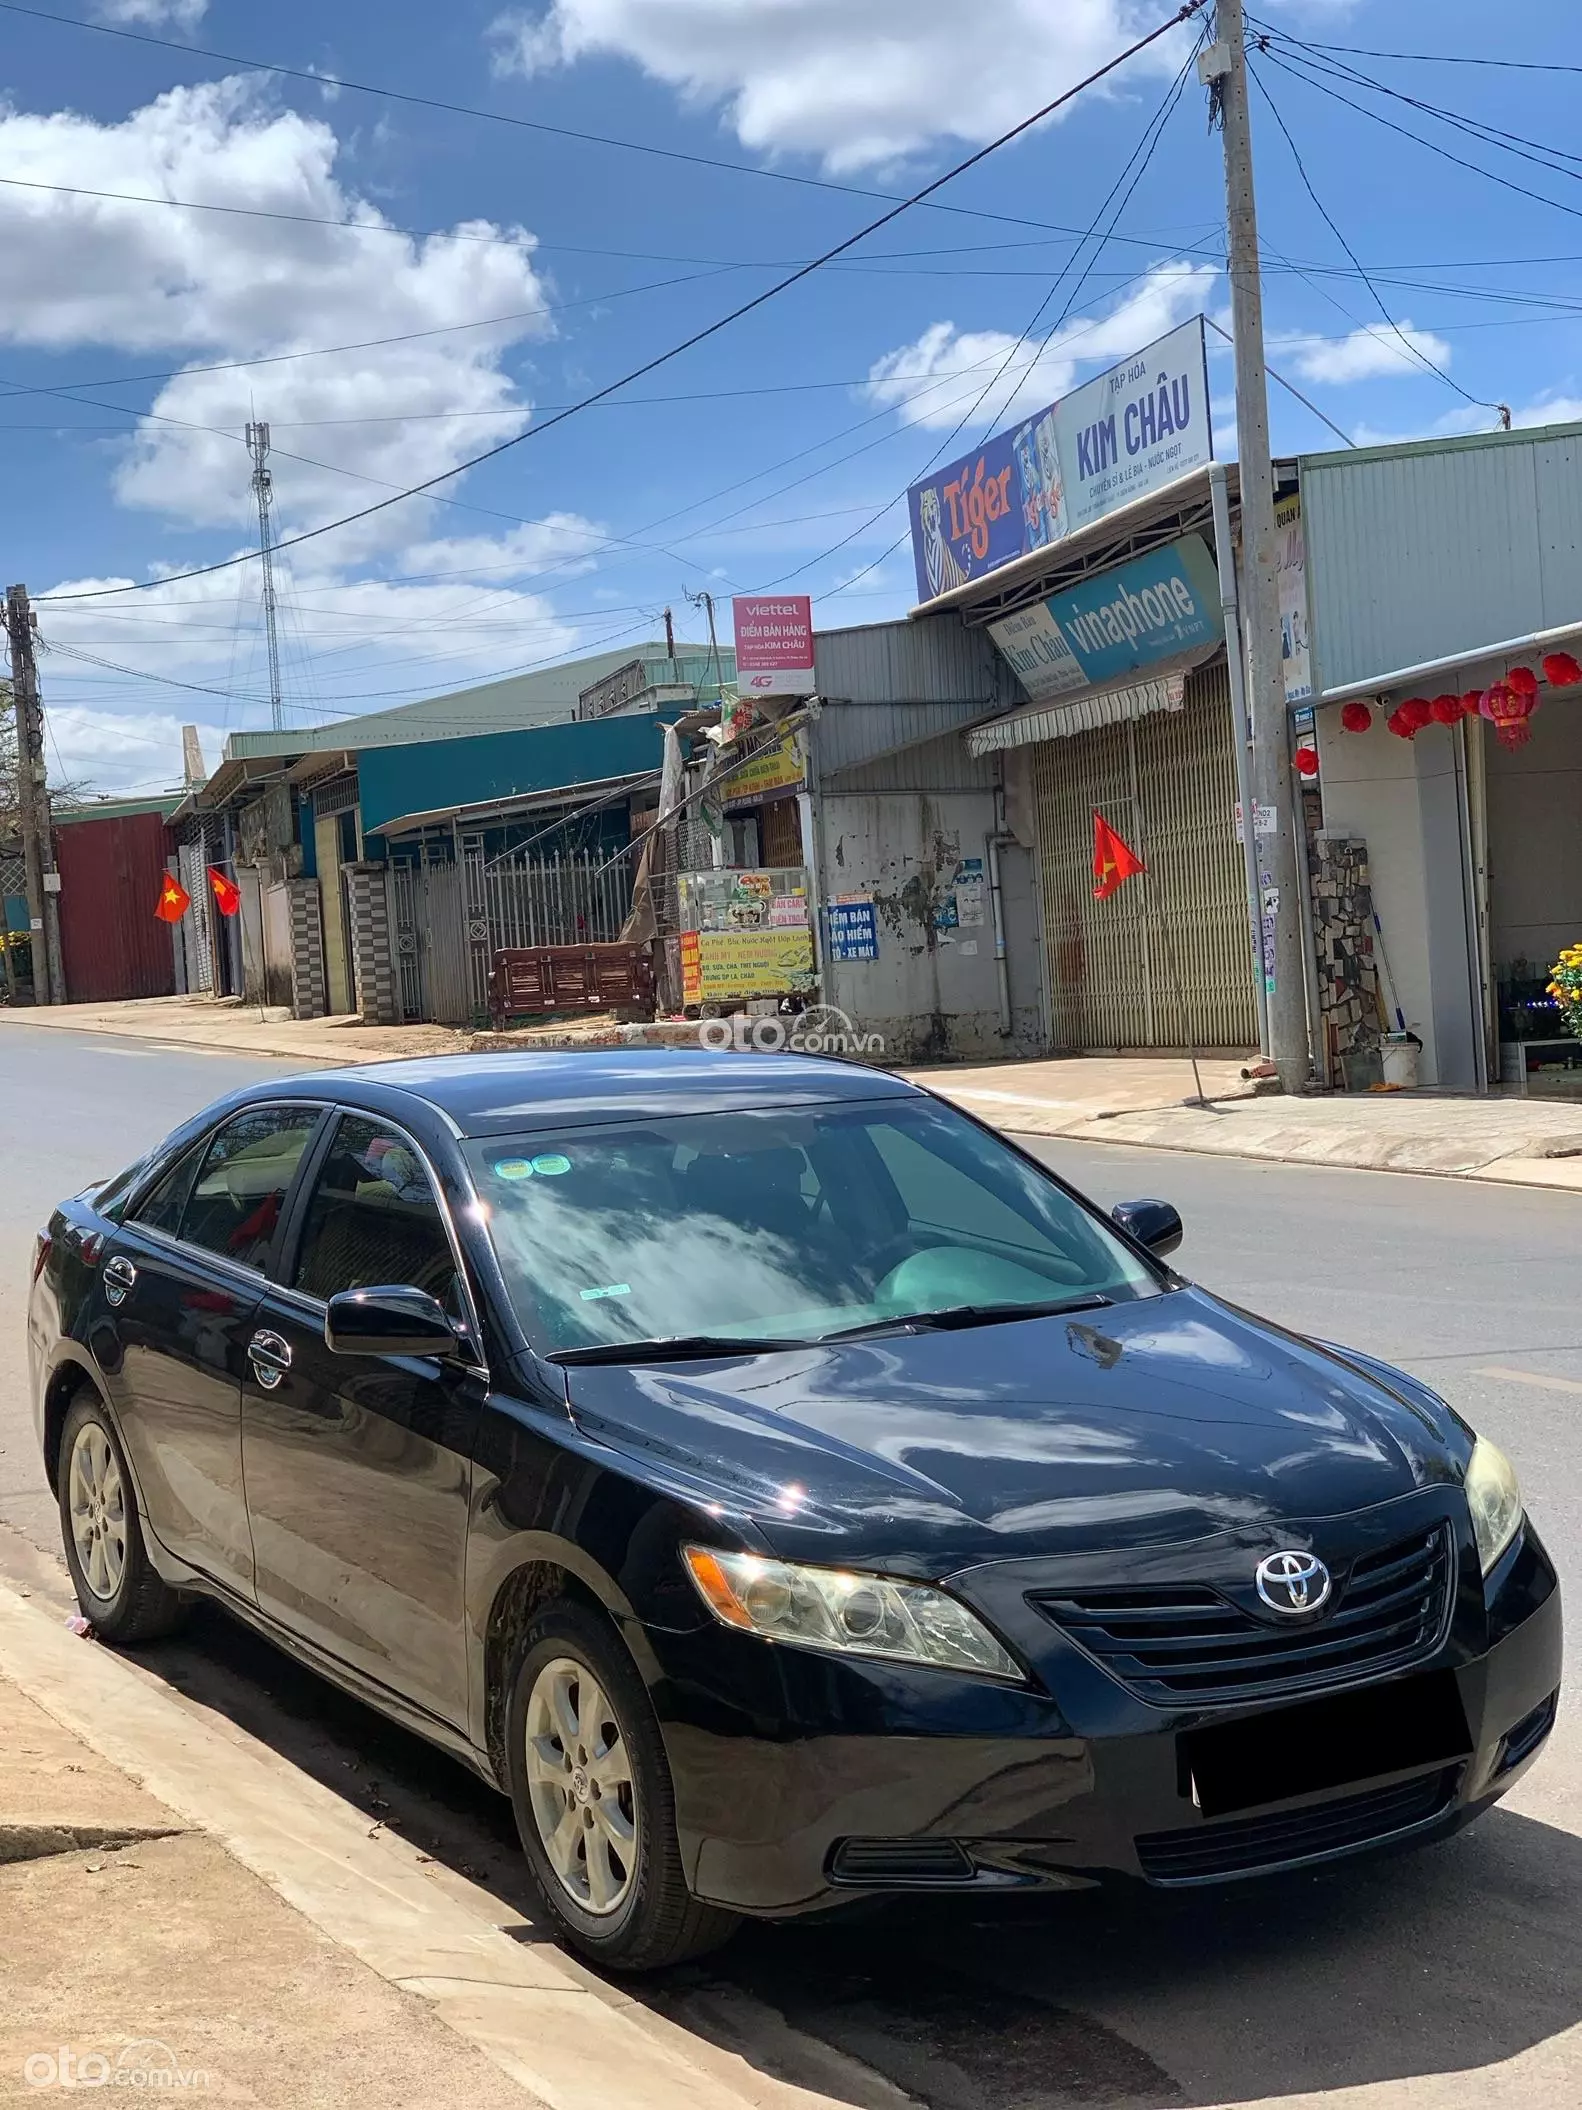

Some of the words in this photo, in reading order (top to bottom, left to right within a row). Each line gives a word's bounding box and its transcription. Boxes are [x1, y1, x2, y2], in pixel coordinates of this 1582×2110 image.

[1076, 414, 1118, 482] KIM
[1124, 371, 1190, 456] CHÂU
[943, 455, 1012, 560] Tiger
[745, 603, 799, 617] viettel
[1065, 576, 1195, 654] vinaphone
[741, 620, 762, 638] ĐIỂM
[764, 641, 781, 649] KIM
[782, 639, 805, 649] CHÂU
[1030, 629, 1071, 664] Châu
[750, 675, 773, 688] 4G
[849, 909, 871, 924] BÁN
[846, 924, 872, 941] HIỂM
[847, 946, 857, 958] XE
[857, 943, 874, 958] MÁY
